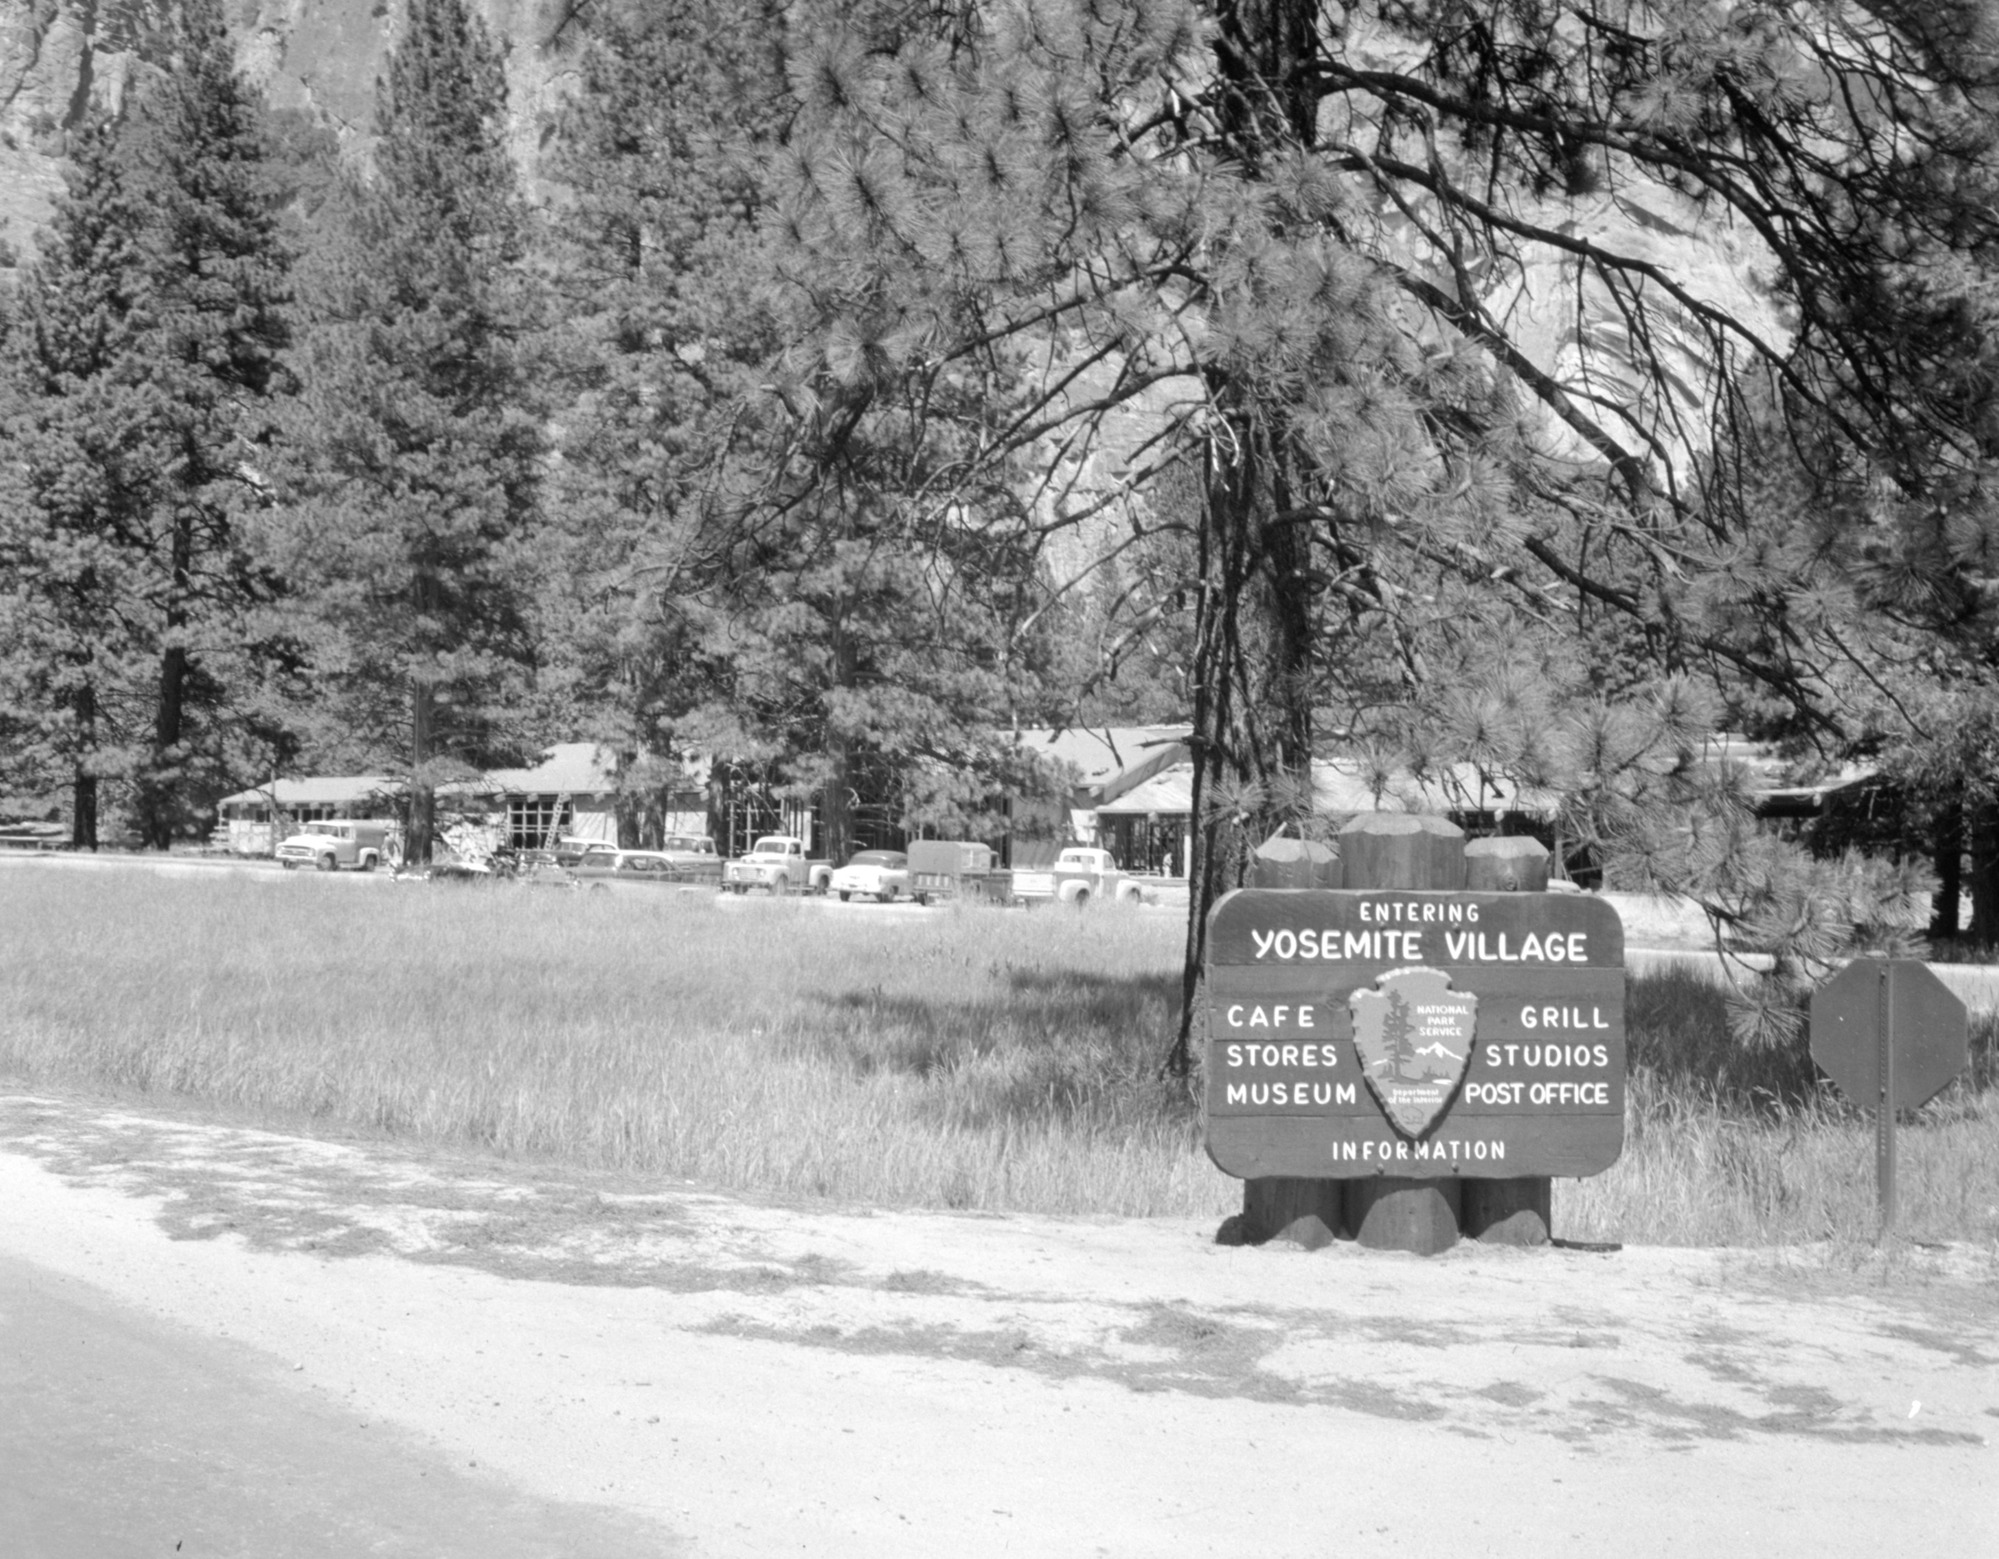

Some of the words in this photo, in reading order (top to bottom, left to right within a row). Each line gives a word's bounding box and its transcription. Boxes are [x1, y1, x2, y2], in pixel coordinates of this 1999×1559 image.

[1360, 902, 1478, 923] ENTERING
[1252, 930, 1422, 959] YOSEMITE
[1445, 932, 1587, 961] VILLAGE
[1228, 1005, 1314, 1027] CAFE
[1417, 1005, 1469, 1014] NATIONAL
[1521, 1006, 1608, 1028] GRILL
[1428, 1016, 1455, 1025] PARK
[1420, 1027, 1462, 1036] SERVICE
[1228, 1045, 1337, 1066] STORES
[1487, 1045, 1608, 1066] STUDIOS
[1228, 1083, 1355, 1104] MUSEUM
[1466, 1083, 1524, 1104] POST
[1530, 1083, 1608, 1104] OFFICE
[1333, 1141, 1504, 1160] INFORMATION
